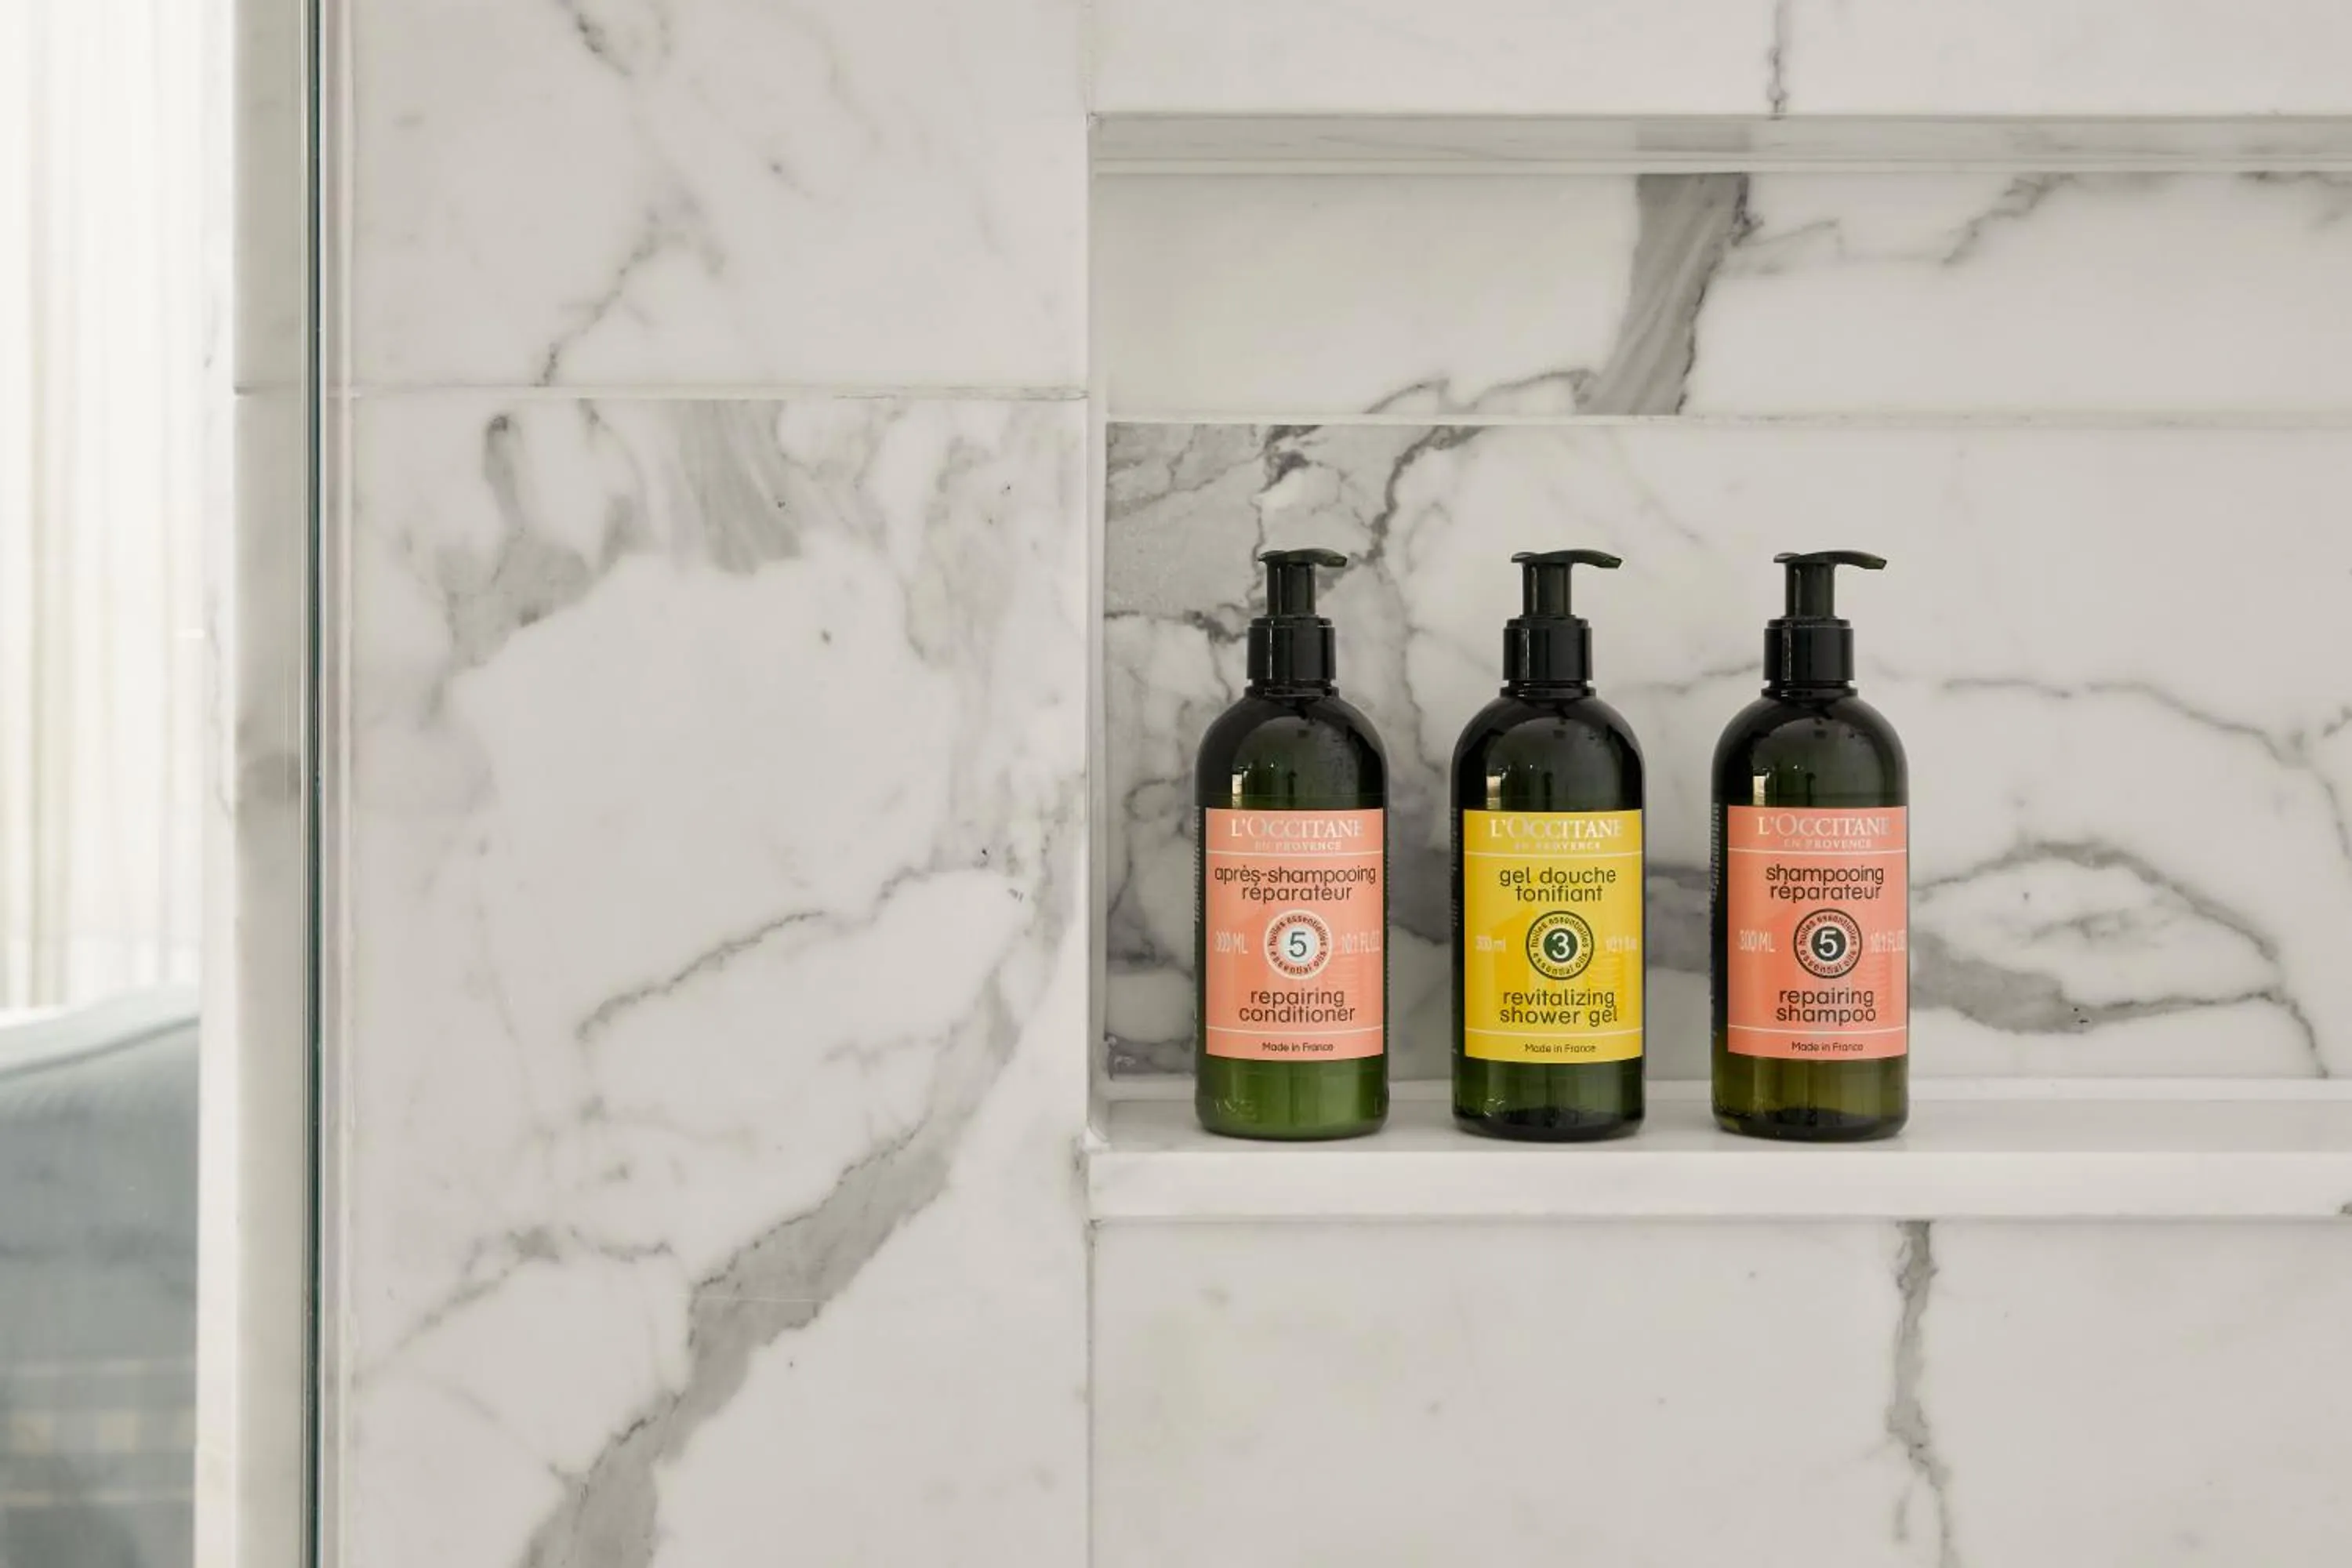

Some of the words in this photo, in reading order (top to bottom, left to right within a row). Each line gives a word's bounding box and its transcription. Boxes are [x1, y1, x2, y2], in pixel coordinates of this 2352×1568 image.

[1231, 815, 1364, 839] L'OCCITANE
[1490, 815, 1623, 839] L'OCCITANE
[1757, 812, 1891, 837] L'OCCITANE
[1275, 840, 1342, 851] PROVENCE
[1805, 839, 1872, 849] PROVENCE
[1214, 865, 1376, 887] après-shampooing
[1499, 866, 1531, 887] gel
[1539, 866, 1617, 884] douche
[1766, 863, 1884, 887] shampooing
[1242, 883, 1352, 904] réparateur
[1516, 884, 1603, 902] tonifiant
[1770, 883, 1882, 903] réparateur
[1289, 931, 1307, 957] 5
[1552, 932, 1570, 959] 3
[1819, 930, 1838, 956] 5
[1250, 988, 1345, 1007] repairing
[1503, 988, 1615, 1008] revitalizing
[1779, 988, 1875, 1007] repairing
[1239, 1006, 1356, 1023] conditioner
[1499, 1006, 1581, 1024] shower
[1588, 1006, 1617, 1027] gel
[1776, 1005, 1876, 1026] shampoo
[1261, 1042, 1290, 1051] Made
[1291, 1042, 1301, 1051] in
[1302, 1042, 1334, 1051] France
[1524, 1043, 1552, 1053] Made
[1553, 1043, 1563, 1053] in
[1564, 1044, 1596, 1053] France
[1791, 1041, 1819, 1051] Made
[1821, 1041, 1831, 1051] in
[1832, 1042, 1864, 1051] France
